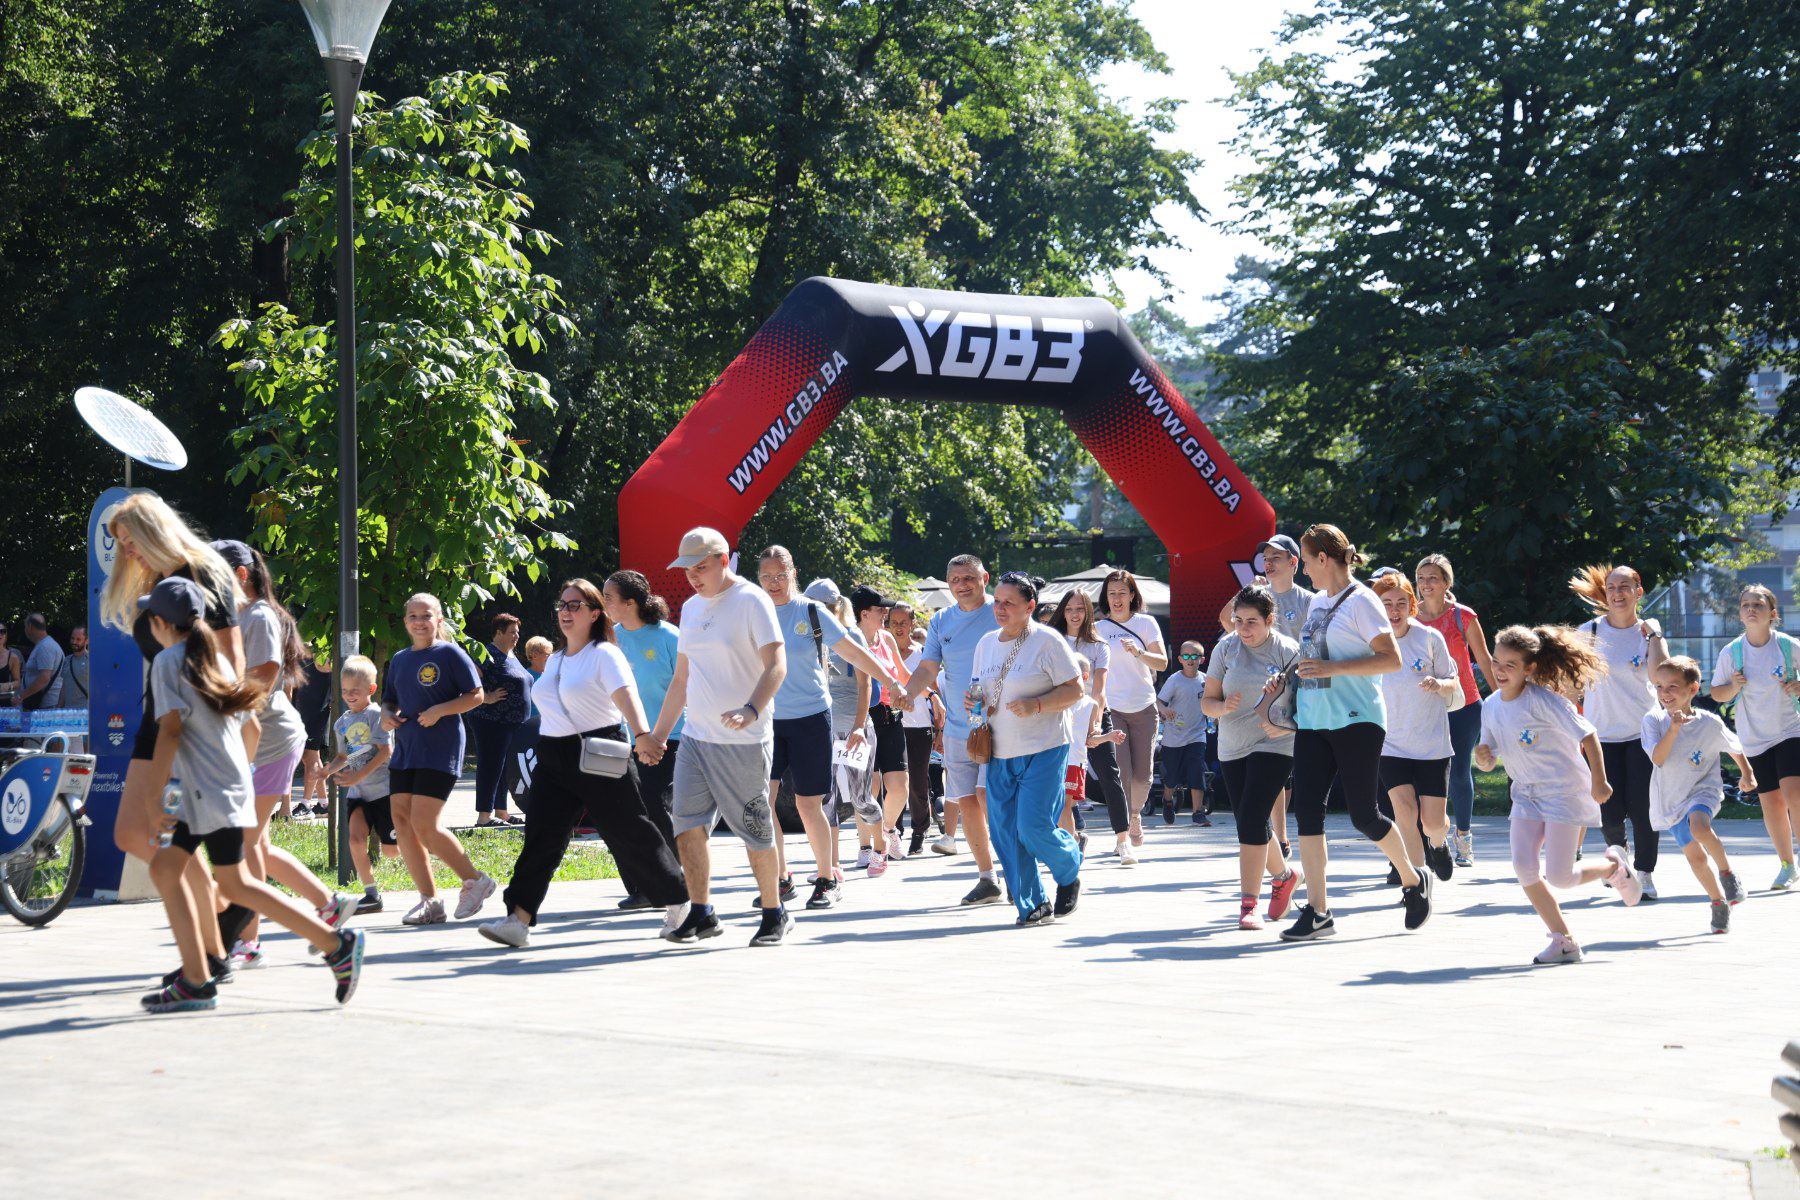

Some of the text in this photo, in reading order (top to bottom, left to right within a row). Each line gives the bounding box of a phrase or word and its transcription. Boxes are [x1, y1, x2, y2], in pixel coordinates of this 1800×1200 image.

[728, 350, 848, 494] WWW.GB3.BA
[1128, 367, 1241, 513] WWW.GB3.BA
[836, 749, 863, 762] 1412
[90, 779, 121, 793] nextbike
[745, 818, 764, 838] SPORT
